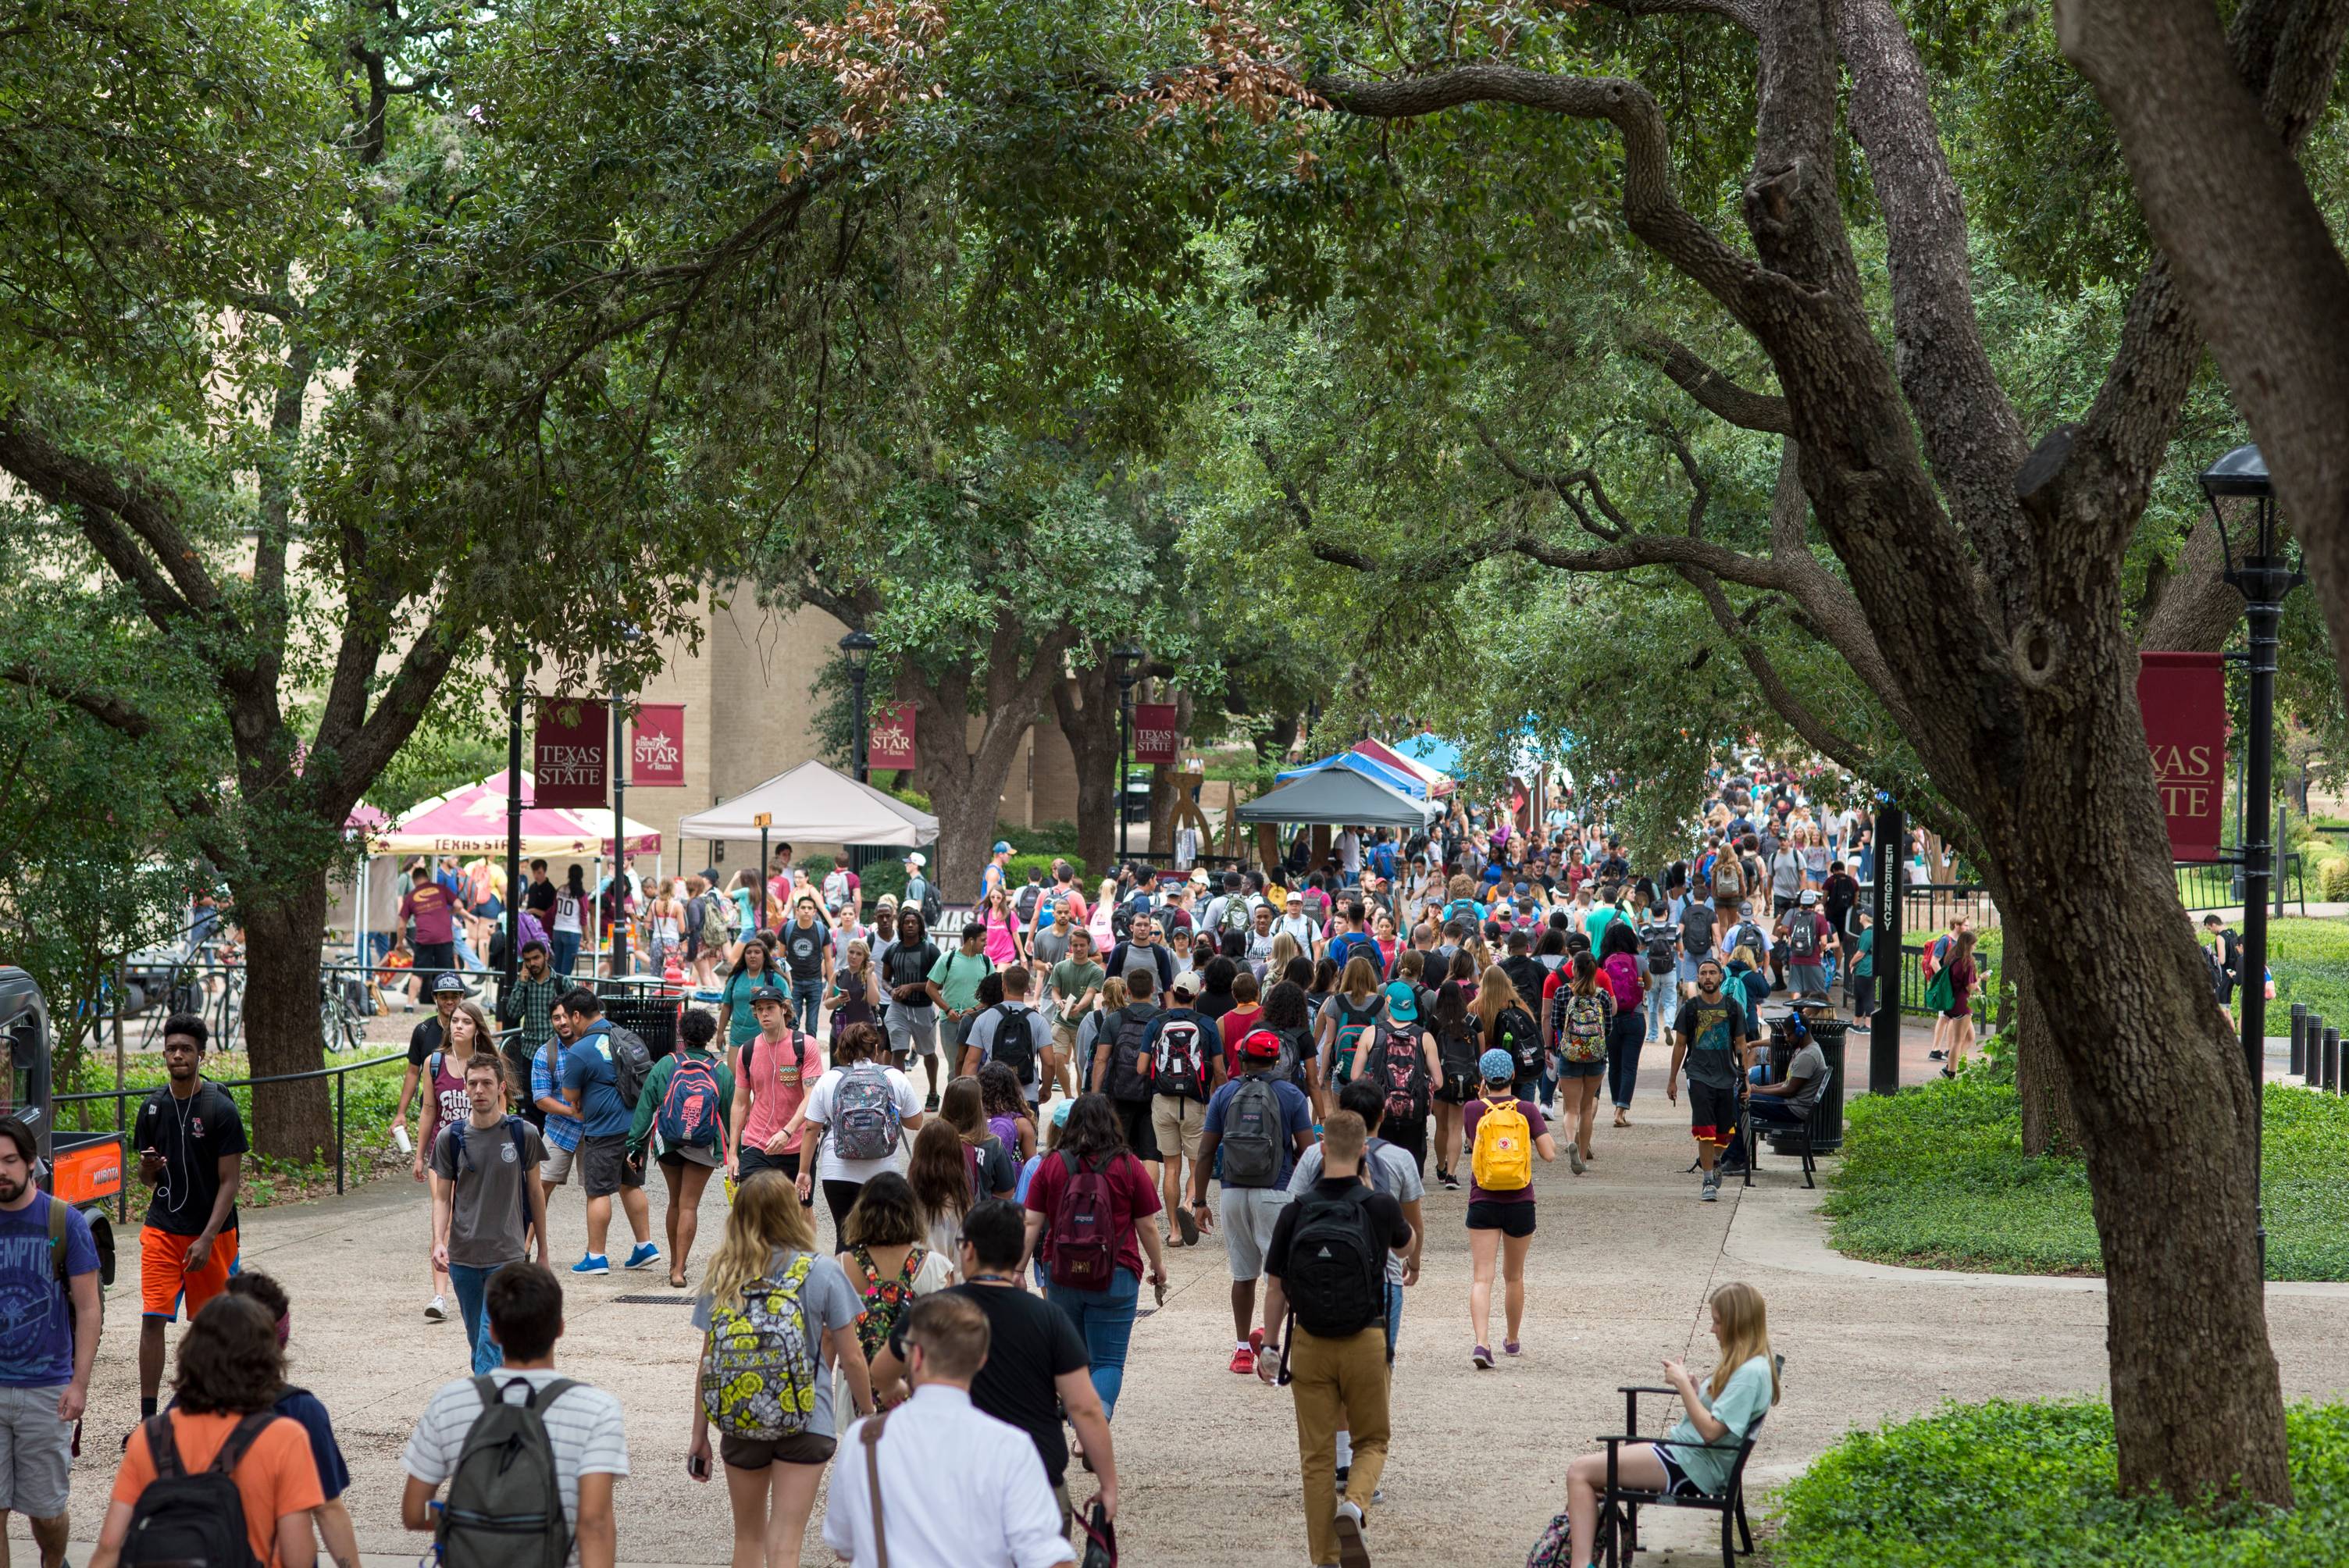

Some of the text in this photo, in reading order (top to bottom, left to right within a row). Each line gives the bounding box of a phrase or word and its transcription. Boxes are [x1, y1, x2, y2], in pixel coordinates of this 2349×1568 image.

[872, 736, 911, 750] STAR
[1138, 729, 1171, 739] TEXAS
[539, 745, 601, 764] TEXAS
[635, 747, 679, 763] STAR
[1138, 742, 1171, 751] STATE
[2148, 745, 2211, 776] XAS
[539, 768, 601, 786] STATE
[434, 839, 526, 850] TEXAS STAE
[1884, 844, 1894, 932] EMERGENCY
[929, 911, 975, 932] XAS
[439, 1089, 471, 1110] Filth
[684, 1107, 696, 1134] NORTH
[692, 1107, 701, 1127] FACE
[94, 1166, 119, 1185] KUBOTA
